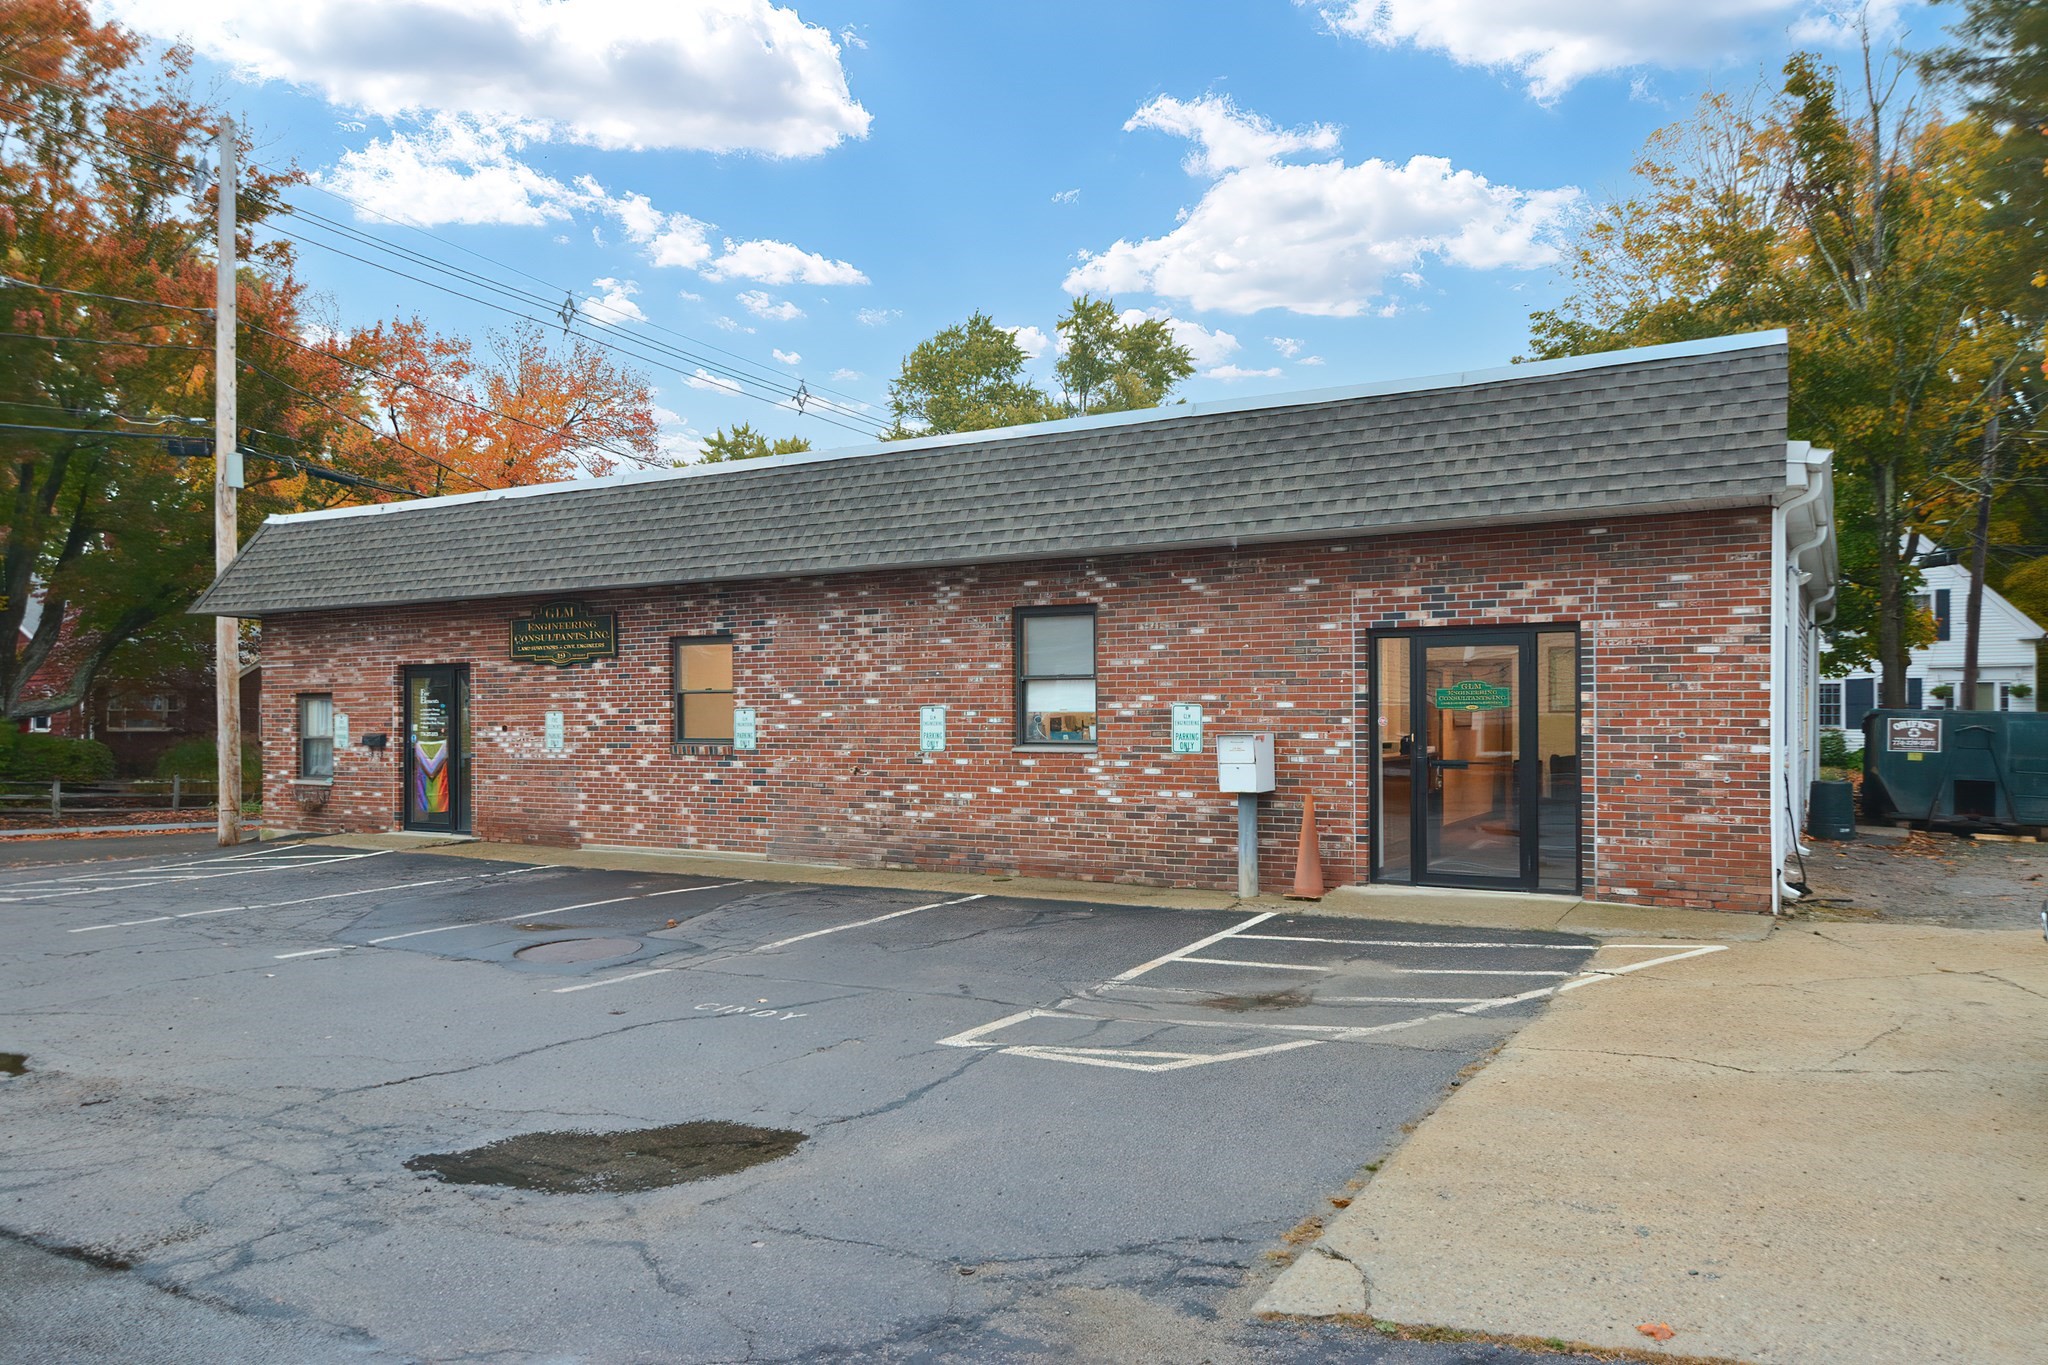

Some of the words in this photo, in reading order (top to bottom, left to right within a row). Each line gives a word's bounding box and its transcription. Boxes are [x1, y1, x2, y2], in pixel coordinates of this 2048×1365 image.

[527, 620, 597, 631] ENGINEERING
[589, 630, 610, 640] INC.
[1892, 721, 1937, 732] ORIFICE
[1175, 732, 1199, 740] PARKING
[1179, 741, 1195, 750] ONLY
[694, 1003, 808, 1020] CINDY
